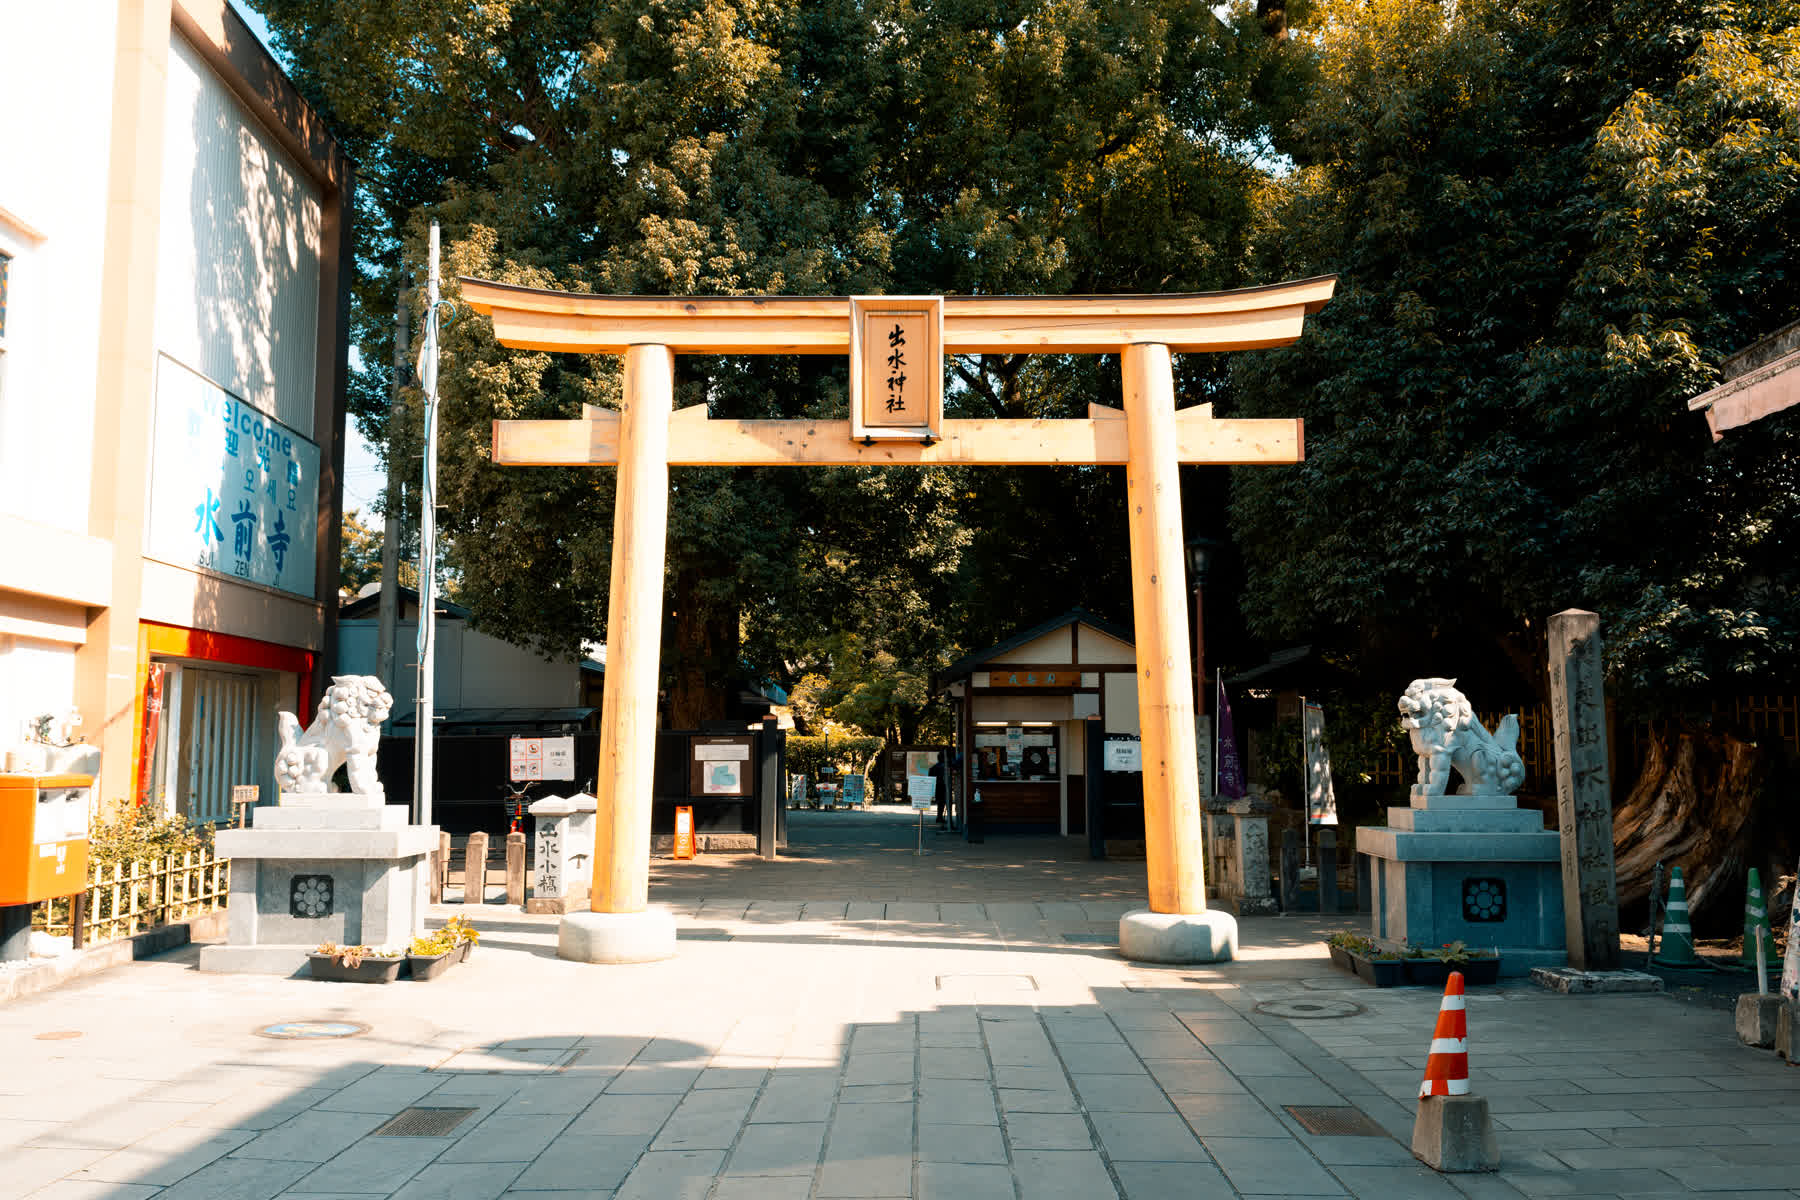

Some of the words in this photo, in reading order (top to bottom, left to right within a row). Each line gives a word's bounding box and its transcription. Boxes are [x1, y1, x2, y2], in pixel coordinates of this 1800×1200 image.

[886, 323, 907, 413] 出水神社
[195, 487, 290, 573] 水前寺
[199, 549, 214, 567] SUI
[234, 560, 249, 578] ZEN
